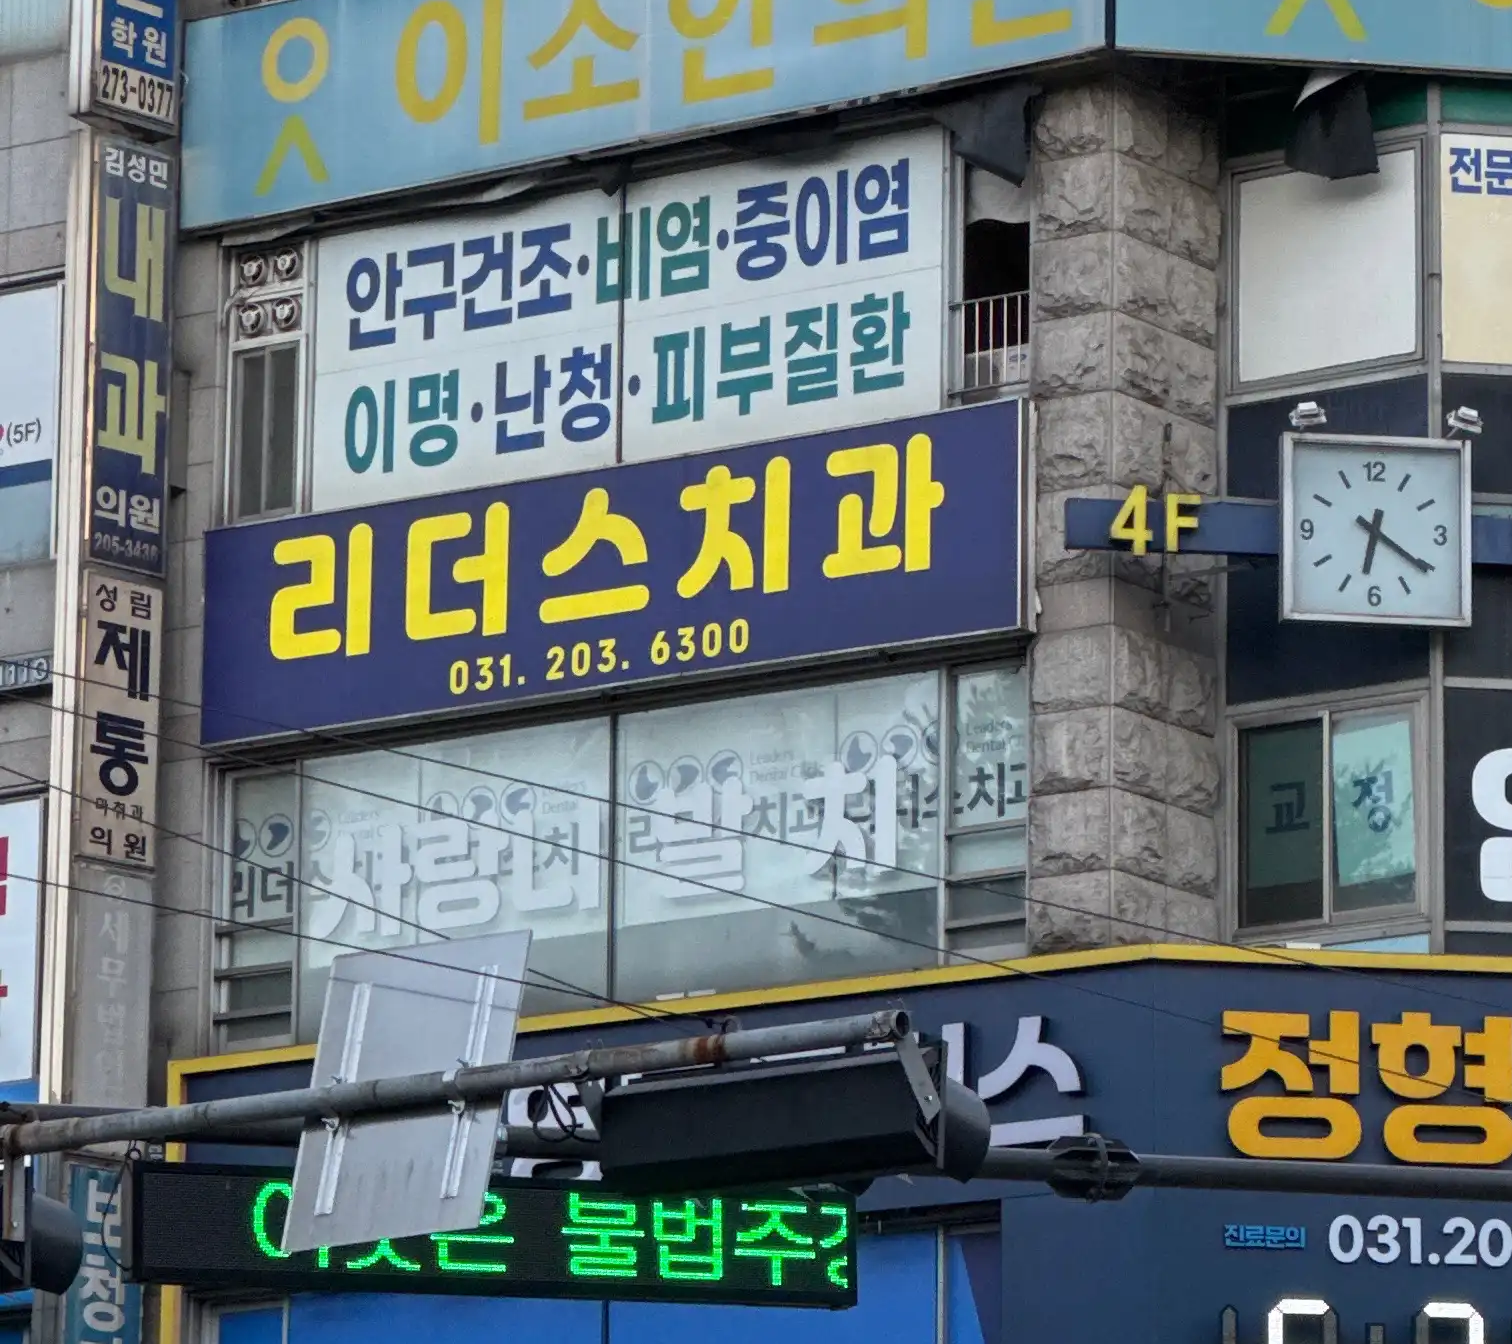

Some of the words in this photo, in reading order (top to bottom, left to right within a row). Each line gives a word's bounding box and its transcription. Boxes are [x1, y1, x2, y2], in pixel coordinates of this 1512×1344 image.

[110, 15, 168, 70] 학원
[100, 64, 175, 121] 273-0377
[104, 146, 169, 192] 김성민
[97, 195, 168, 477] 내과
[6, 417, 42, 447] (5F)
[1361, 460, 1388, 484] 12
[93, 484, 161, 535] 의원
[1108, 484, 1203, 557] 4F
[1299, 518, 1316, 542] 9
[1431, 523, 1449, 547] 3
[268, 432, 946, 662] 리더스치과
[1365, 584, 1383, 608] 6
[88, 825, 148, 863] 의원
[1222, 1222, 1307, 1251] 진료문의
